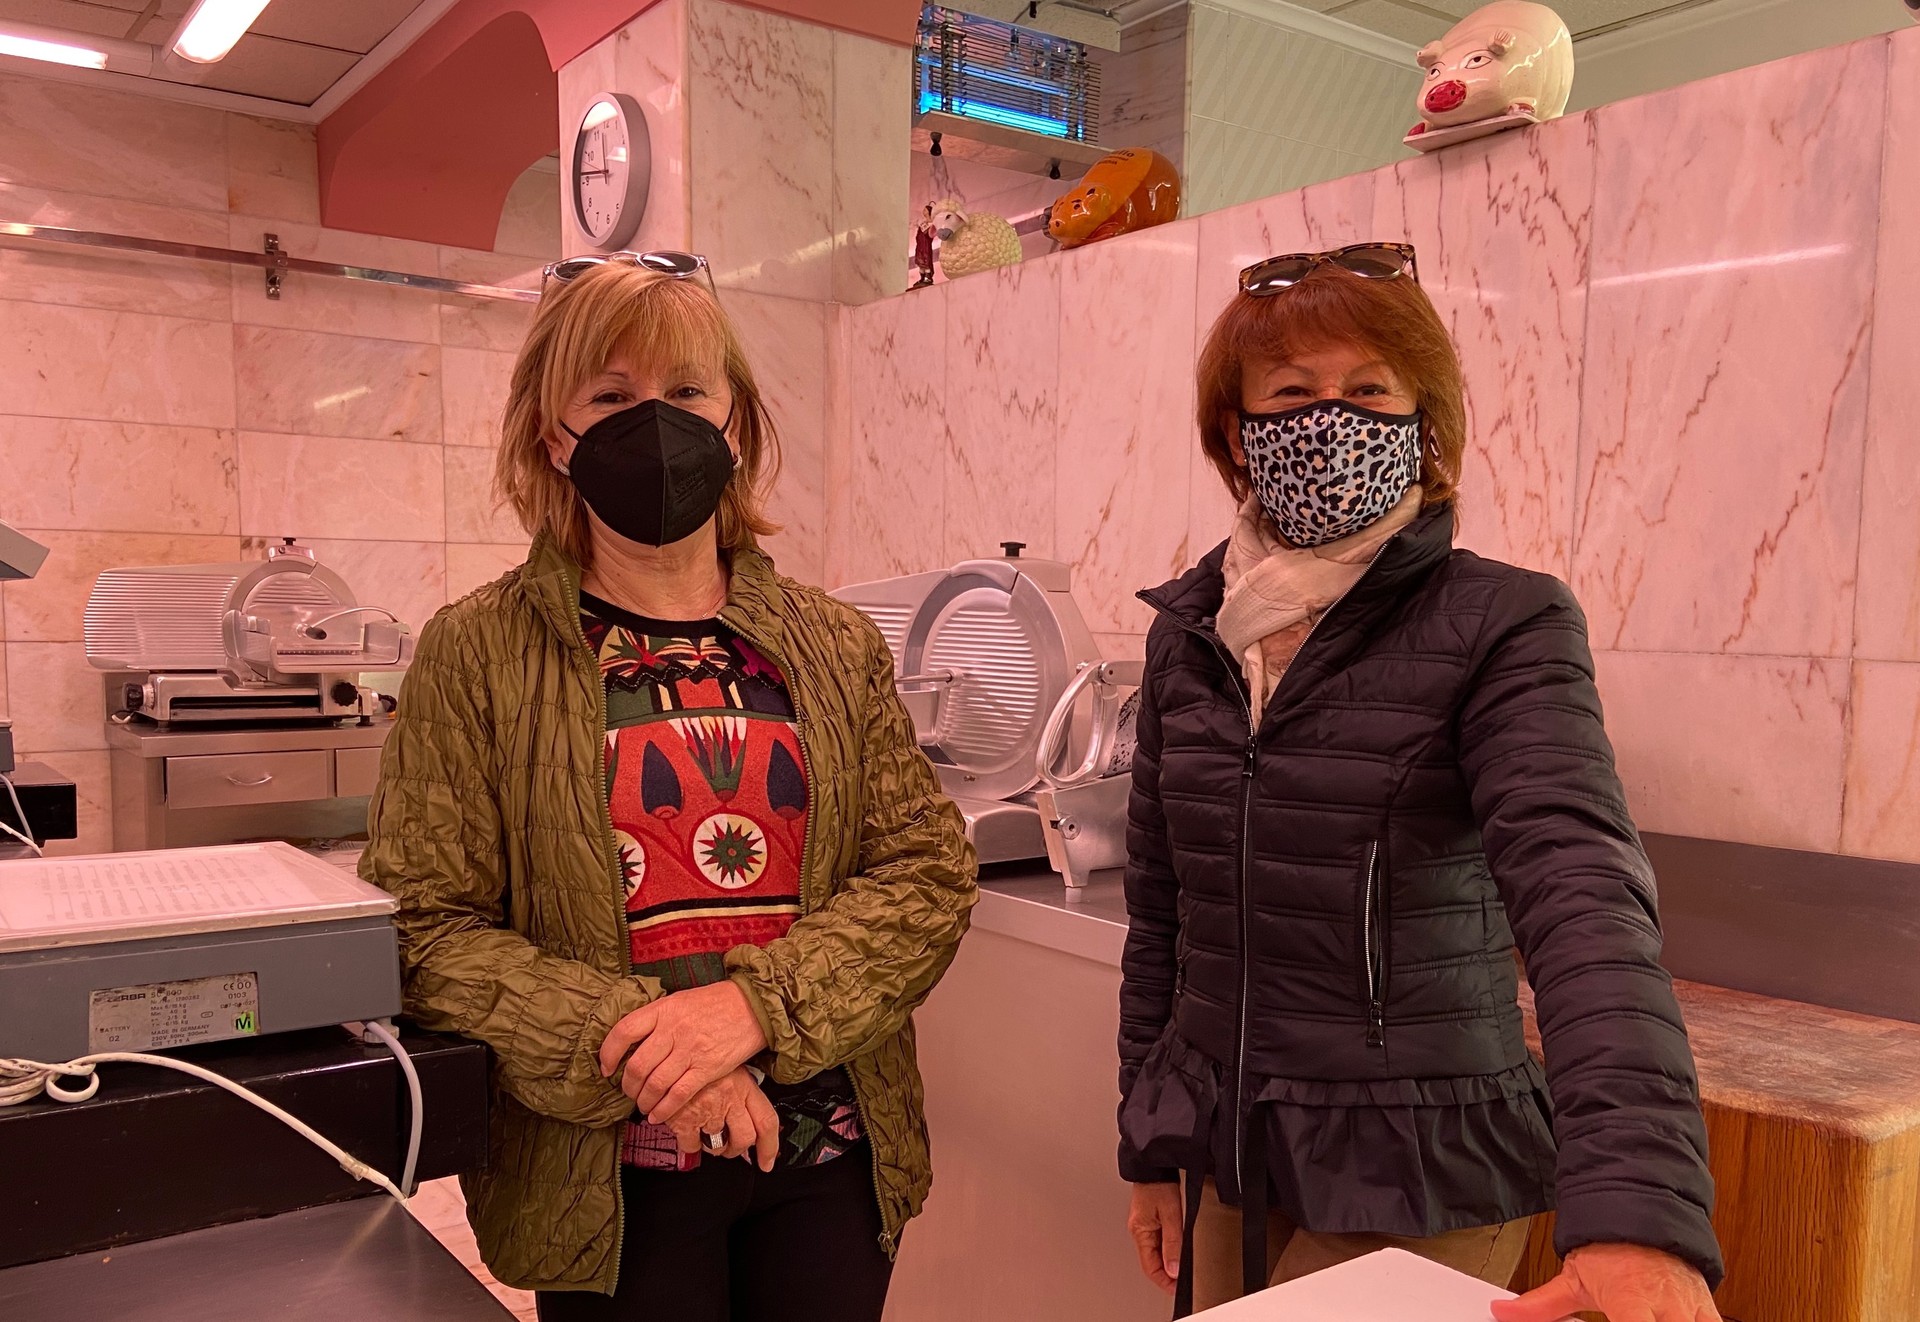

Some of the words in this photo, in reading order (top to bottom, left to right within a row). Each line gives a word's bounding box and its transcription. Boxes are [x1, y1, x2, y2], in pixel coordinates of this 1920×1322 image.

[594, 129, 600, 142] 11
[228, 991, 247, 1000] 0103
[180, 1024, 210, 1032] GERMANY
